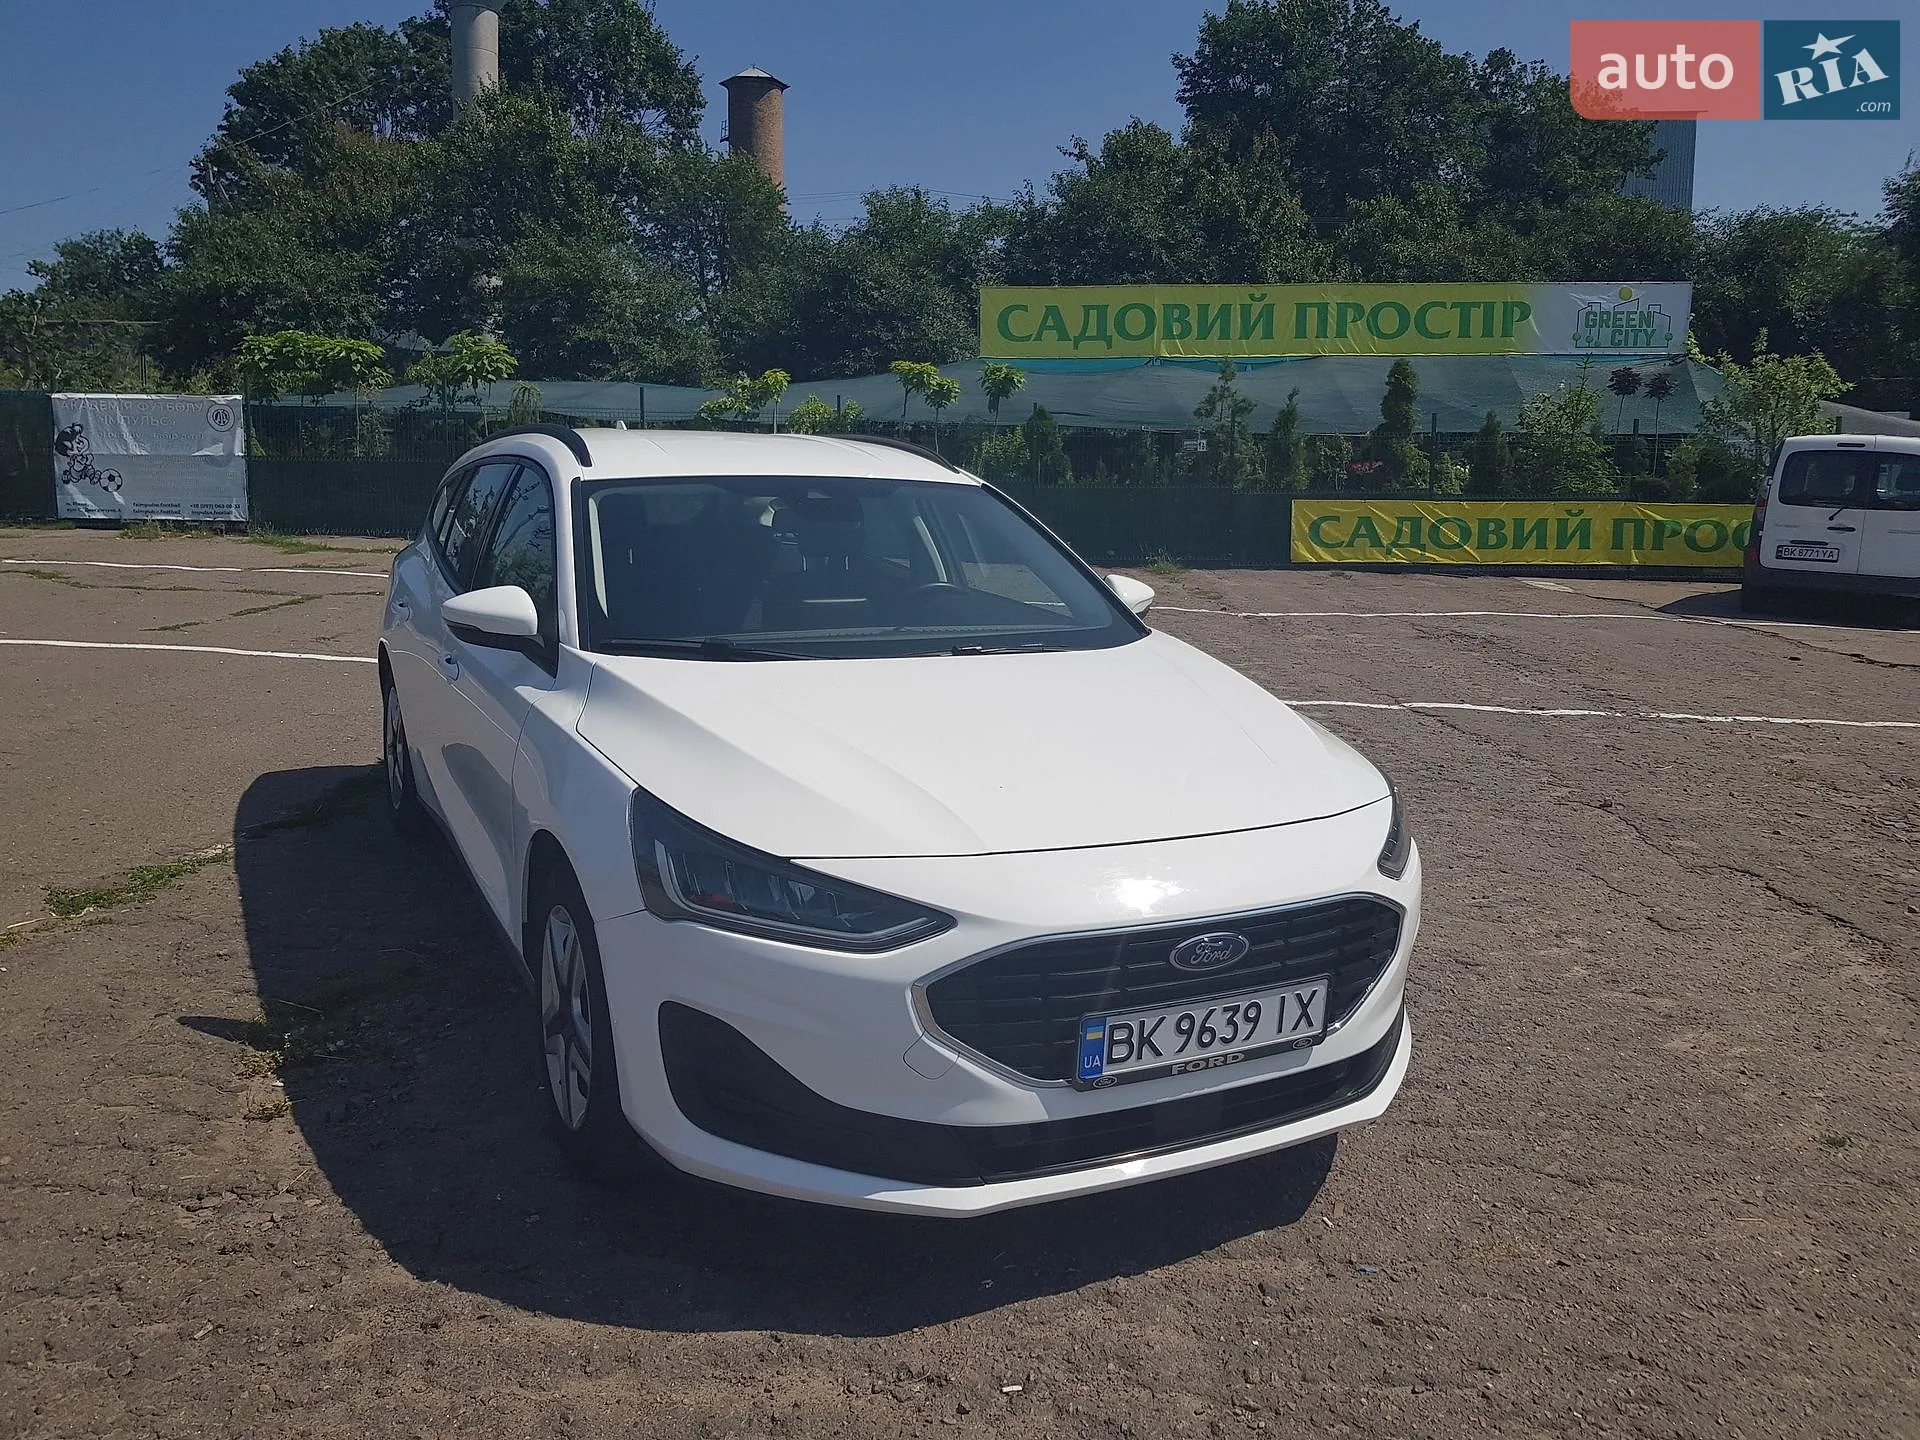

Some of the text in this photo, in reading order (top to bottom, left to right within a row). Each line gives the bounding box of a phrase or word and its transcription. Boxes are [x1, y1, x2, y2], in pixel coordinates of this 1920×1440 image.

[996, 293, 1532, 350] САДОВИЙ ПРОСТІР
[1584, 310, 1653, 329] GREEN
[1610, 328, 1657, 347] CITY
[1307, 508, 1593, 555] САДОВИЙ
[1190, 941, 1233, 964] Ford
[1107, 988, 1319, 1064] BK 9639 IX
[1084, 1055, 1101, 1068] UA
[1171, 1052, 1245, 1075] FORD
